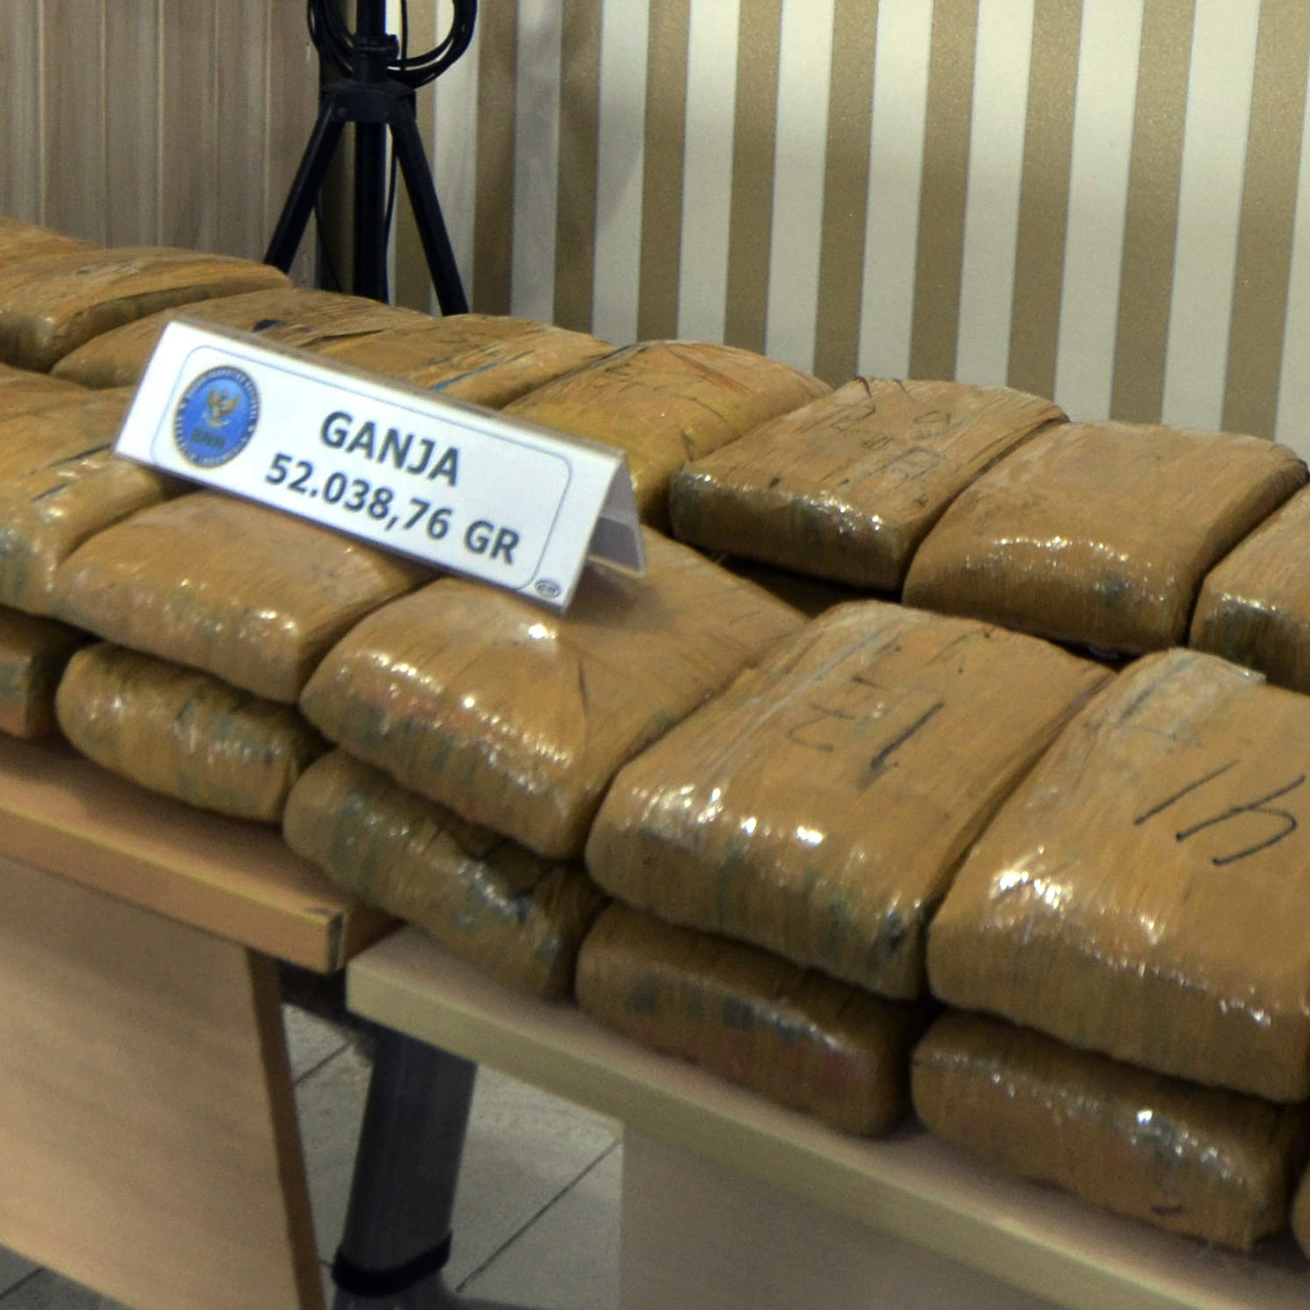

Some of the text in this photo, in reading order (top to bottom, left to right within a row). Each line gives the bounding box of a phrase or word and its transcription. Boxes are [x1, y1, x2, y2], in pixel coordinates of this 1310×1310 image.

[319, 410, 460, 487] GANJA
[264, 452, 520, 566] 52.038,76 GR
